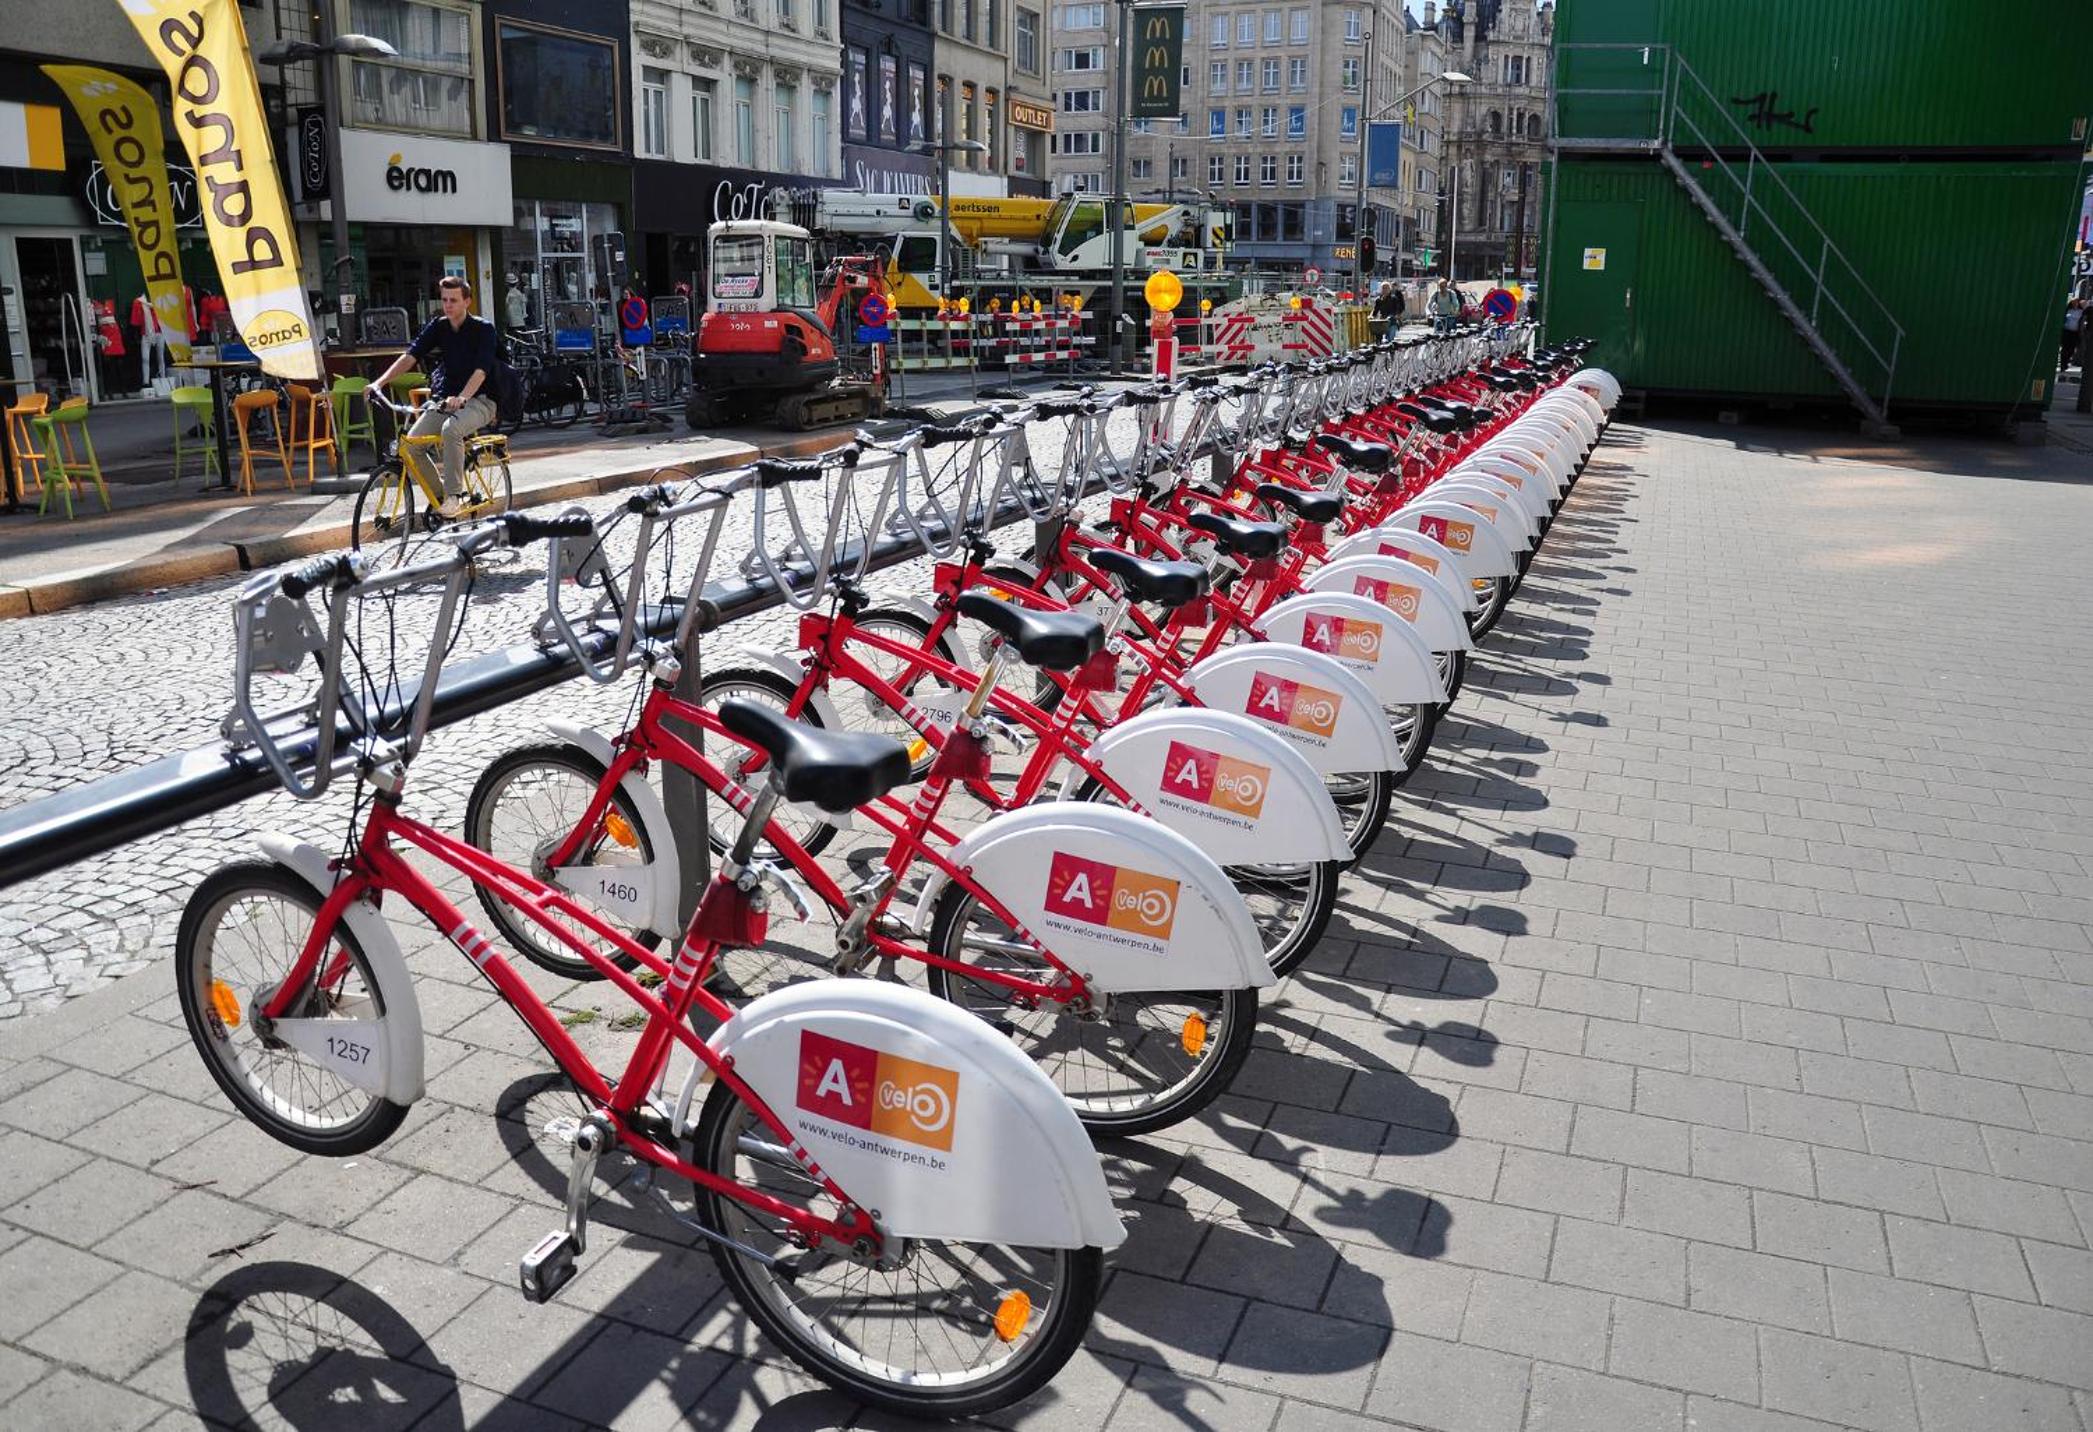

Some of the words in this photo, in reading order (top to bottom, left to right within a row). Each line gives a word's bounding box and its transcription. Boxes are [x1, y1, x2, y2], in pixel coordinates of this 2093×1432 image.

[1015, 105, 1048, 126] OUTLET
[386, 153, 458, 194] éram
[953, 202, 1000, 213] aertssen
[1096, 606, 1110, 616] 37
[1312, 623, 1331, 646] A
[1258, 686, 1281, 713] A
[1174, 758, 1200, 790] A
[599, 879, 637, 903] 1460
[1061, 871, 1094, 909] A
[1045, 918, 1166, 955] www.velo-antwerpen.be
[327, 1036, 371, 1065] 1257
[815, 1057, 853, 1107] A
[798, 1118, 947, 1172] www.velo-antwerpen.be
